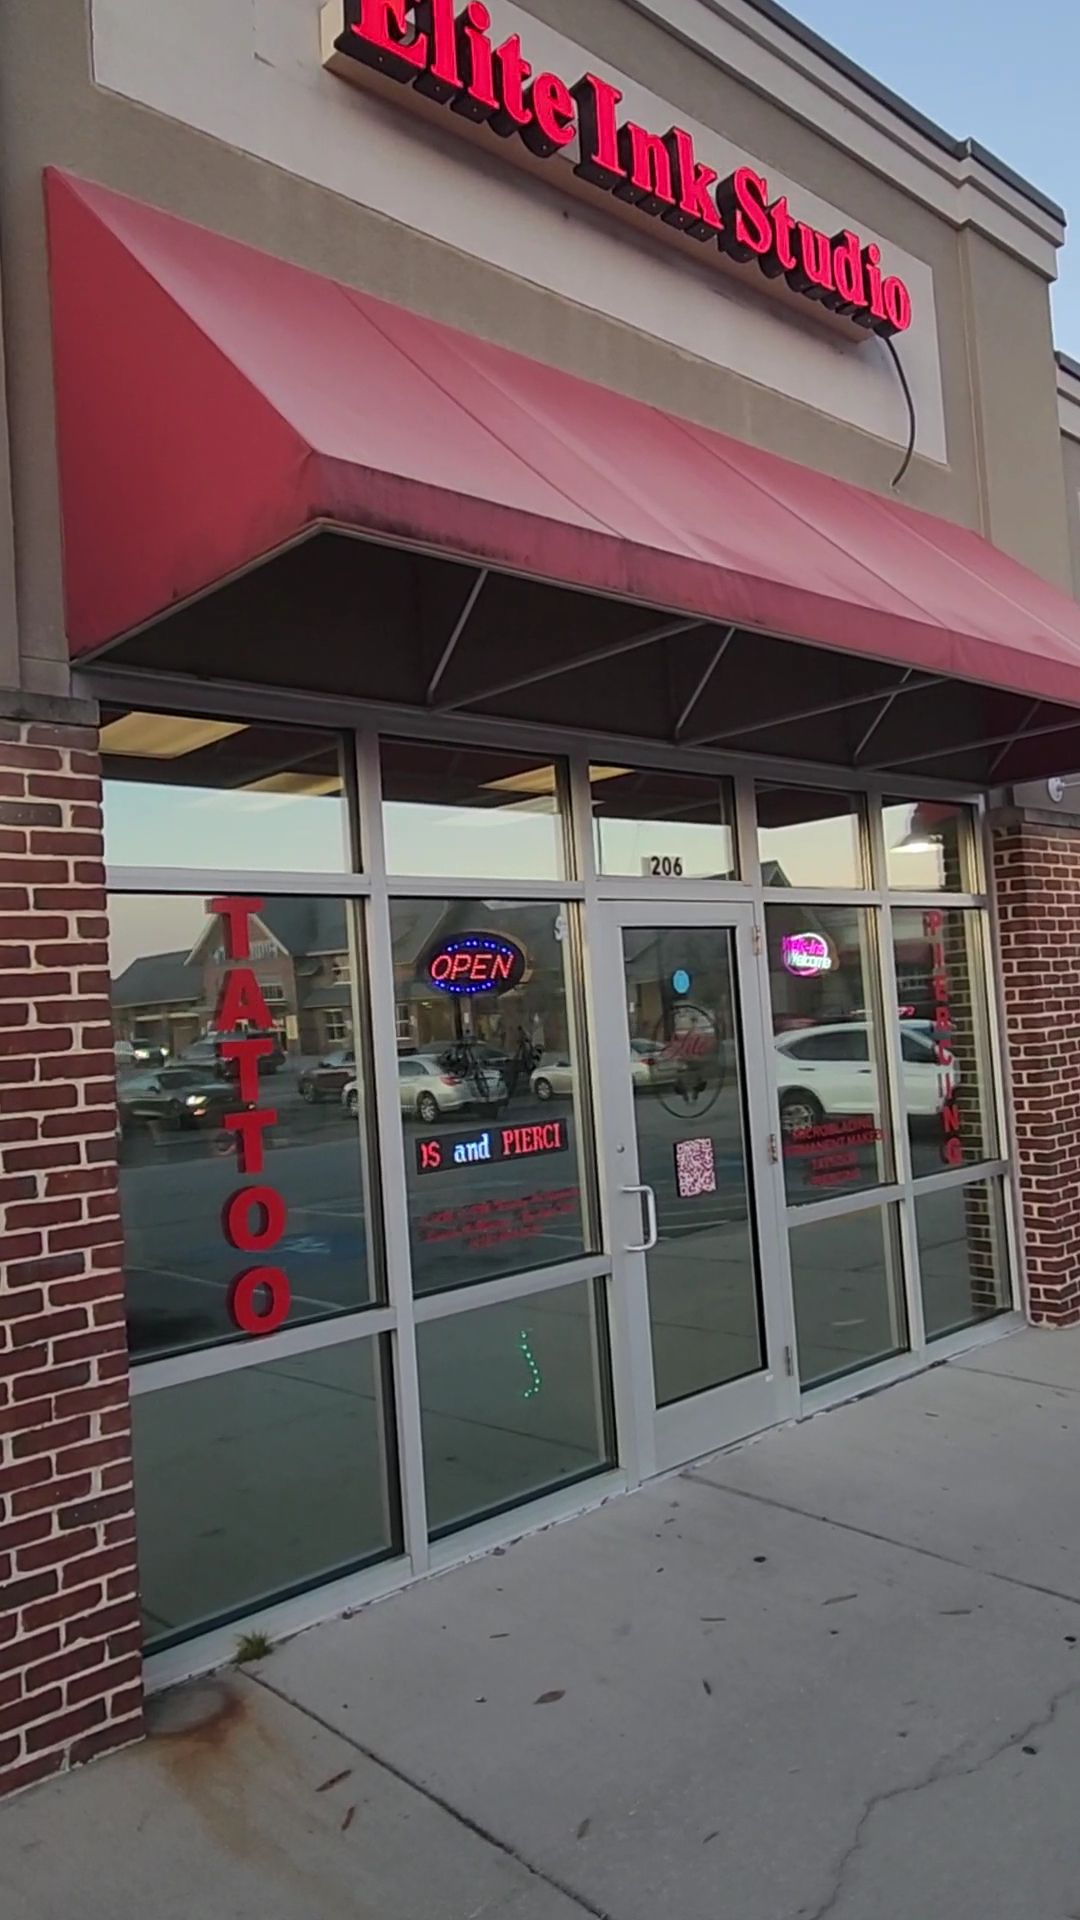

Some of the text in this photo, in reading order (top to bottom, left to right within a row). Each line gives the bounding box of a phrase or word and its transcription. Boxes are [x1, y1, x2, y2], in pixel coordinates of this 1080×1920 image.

[584, 73, 723, 231] Ink
[733, 166, 912, 332] Studio
[650, 855, 683, 876] 206
[431, 953, 515, 981] OPEN
[924, 911, 963, 1164] PIERCING
[205, 896, 292, 1336] TATTOO
[453, 1132, 491, 1163] and
[501, 1122, 561, 1156] PIERCI
